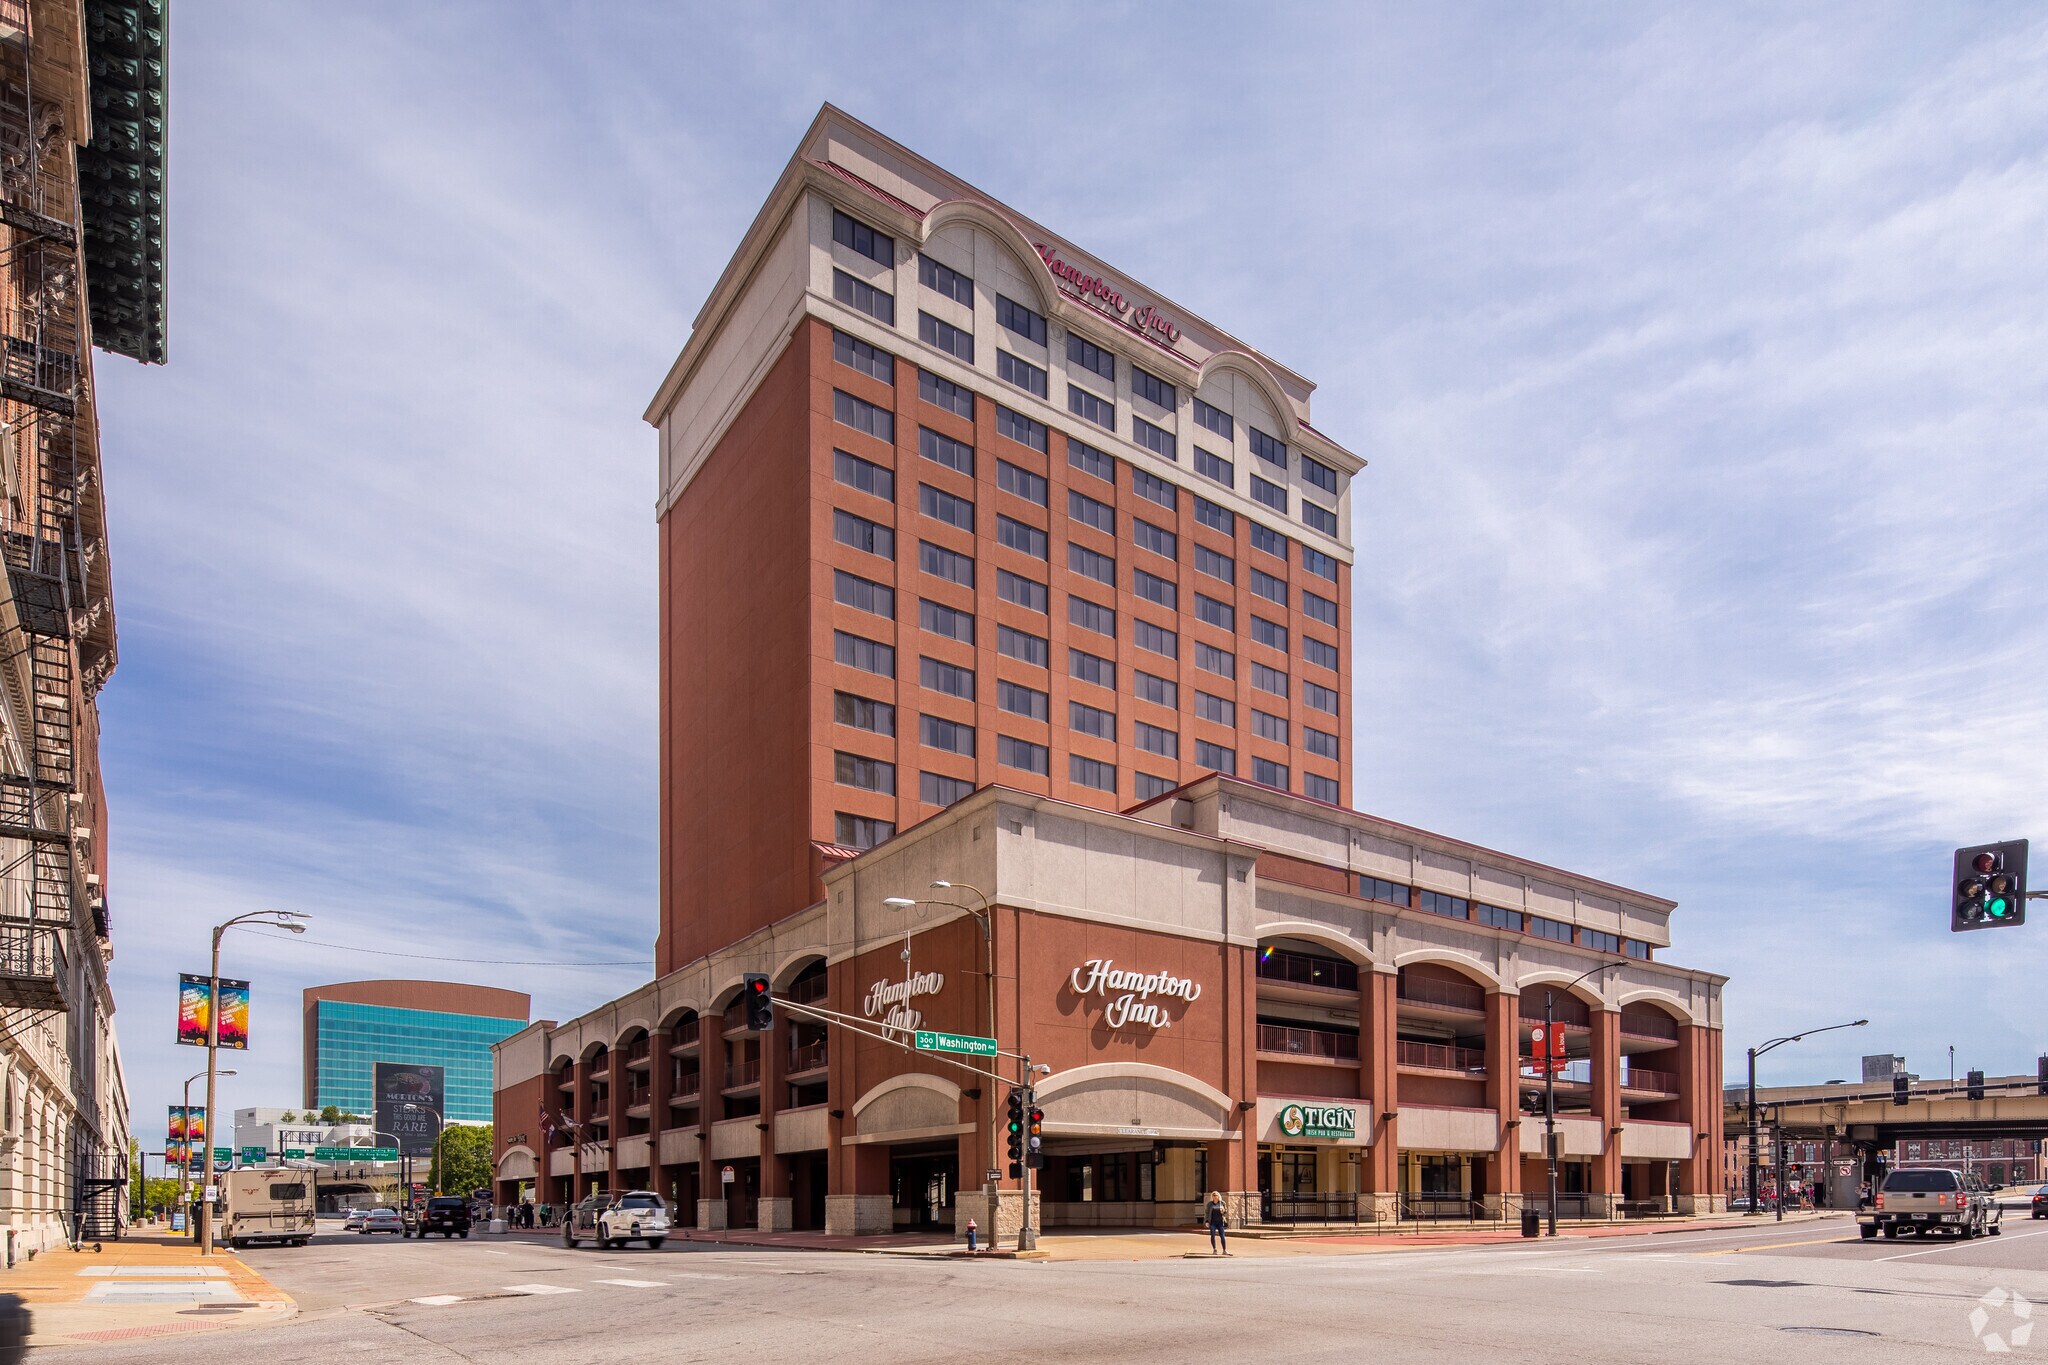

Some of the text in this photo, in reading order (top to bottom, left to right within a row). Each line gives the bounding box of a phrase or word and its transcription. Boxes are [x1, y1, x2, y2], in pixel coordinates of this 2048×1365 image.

[1033, 242, 1182, 342] Hampton Inn
[1071, 959, 1201, 1001] Hampton
[864, 971, 945, 1017] Hampton
[881, 1004, 922, 1040] Inn
[1105, 994, 1168, 1028] Inn
[920, 1036, 934, 1044] 300
[939, 1036, 987, 1052] Washington
[386, 1093, 434, 1102] MORTON'S
[392, 1121, 428, 1132] RARE
[1331, 1130, 1354, 1138] RESTAURANT
